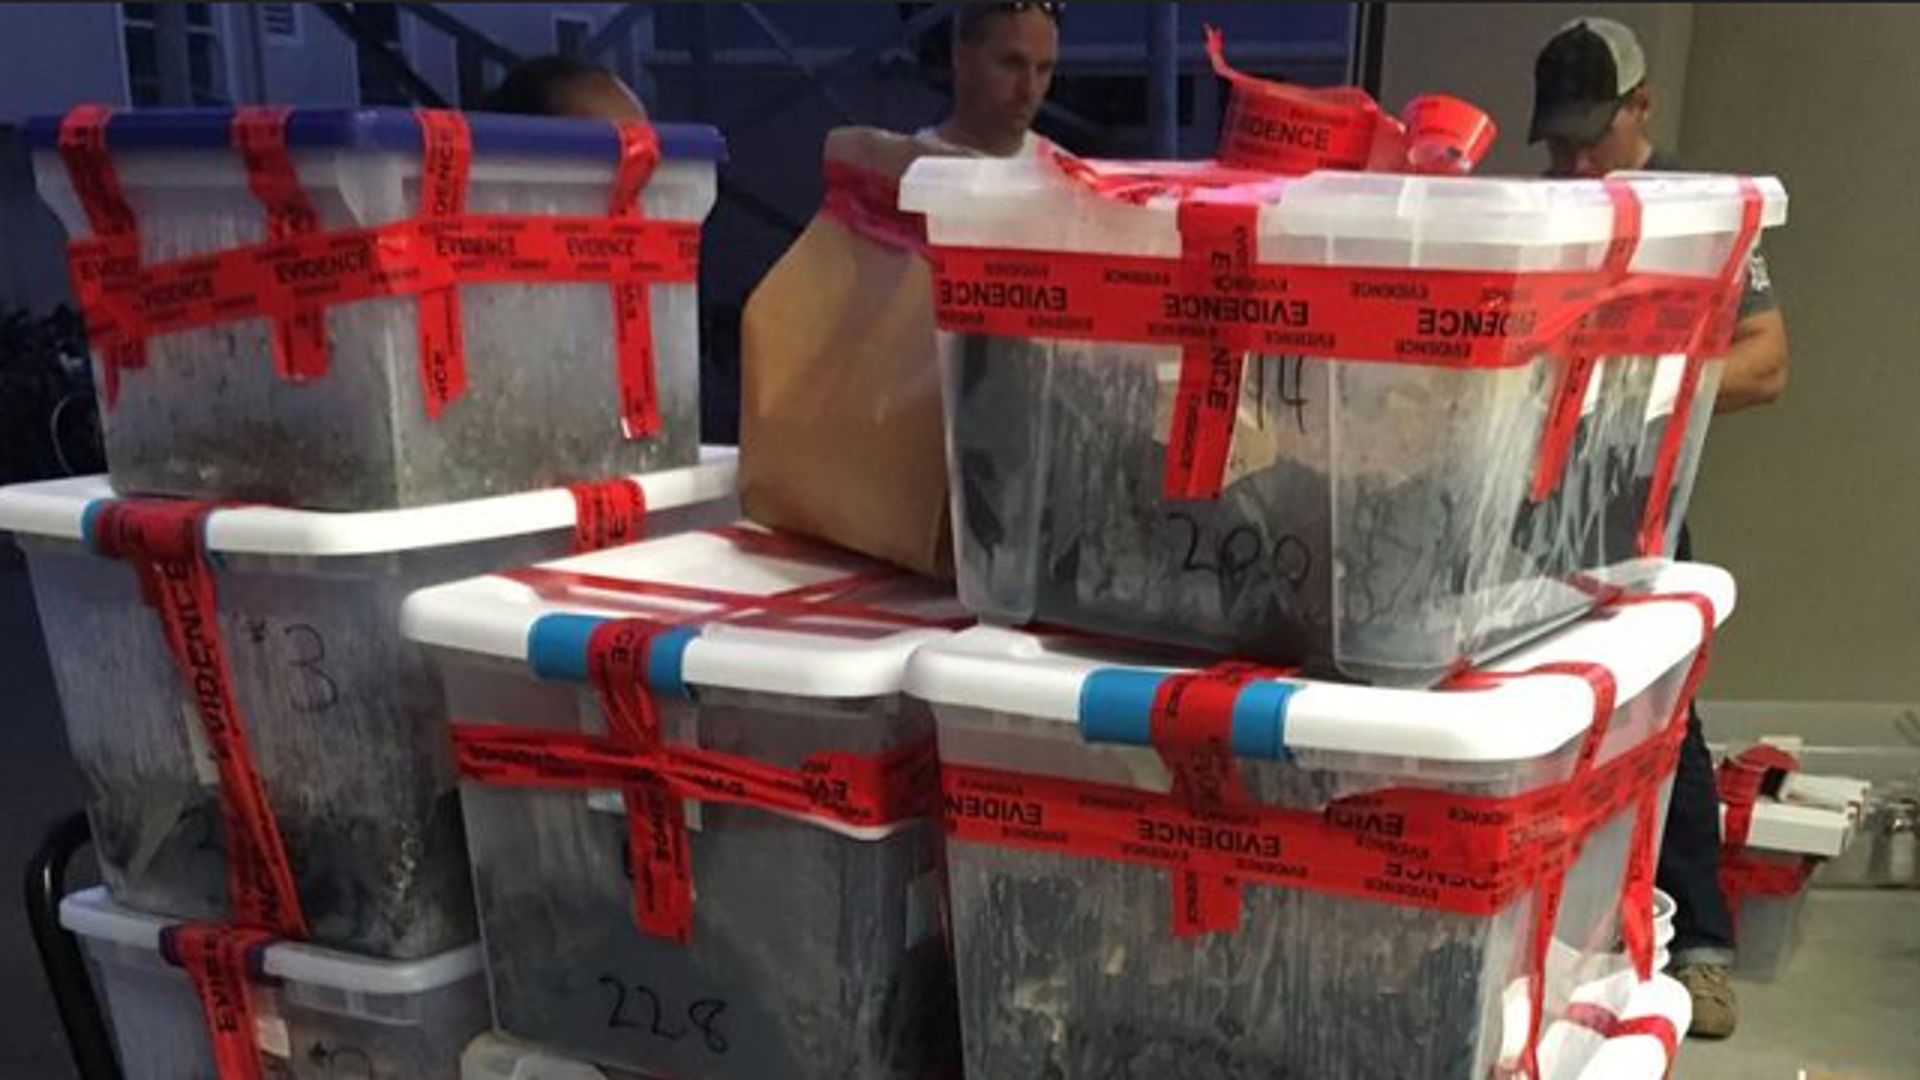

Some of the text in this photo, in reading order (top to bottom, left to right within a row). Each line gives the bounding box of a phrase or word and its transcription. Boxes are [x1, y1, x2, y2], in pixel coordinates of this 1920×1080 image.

[941, 280, 1067, 311] EVIDENCE
[1165, 293, 1309, 327] EVIDENCE
[1139, 818, 1280, 858] EVIDENCE
[597, 974, 729, 1056] 228
